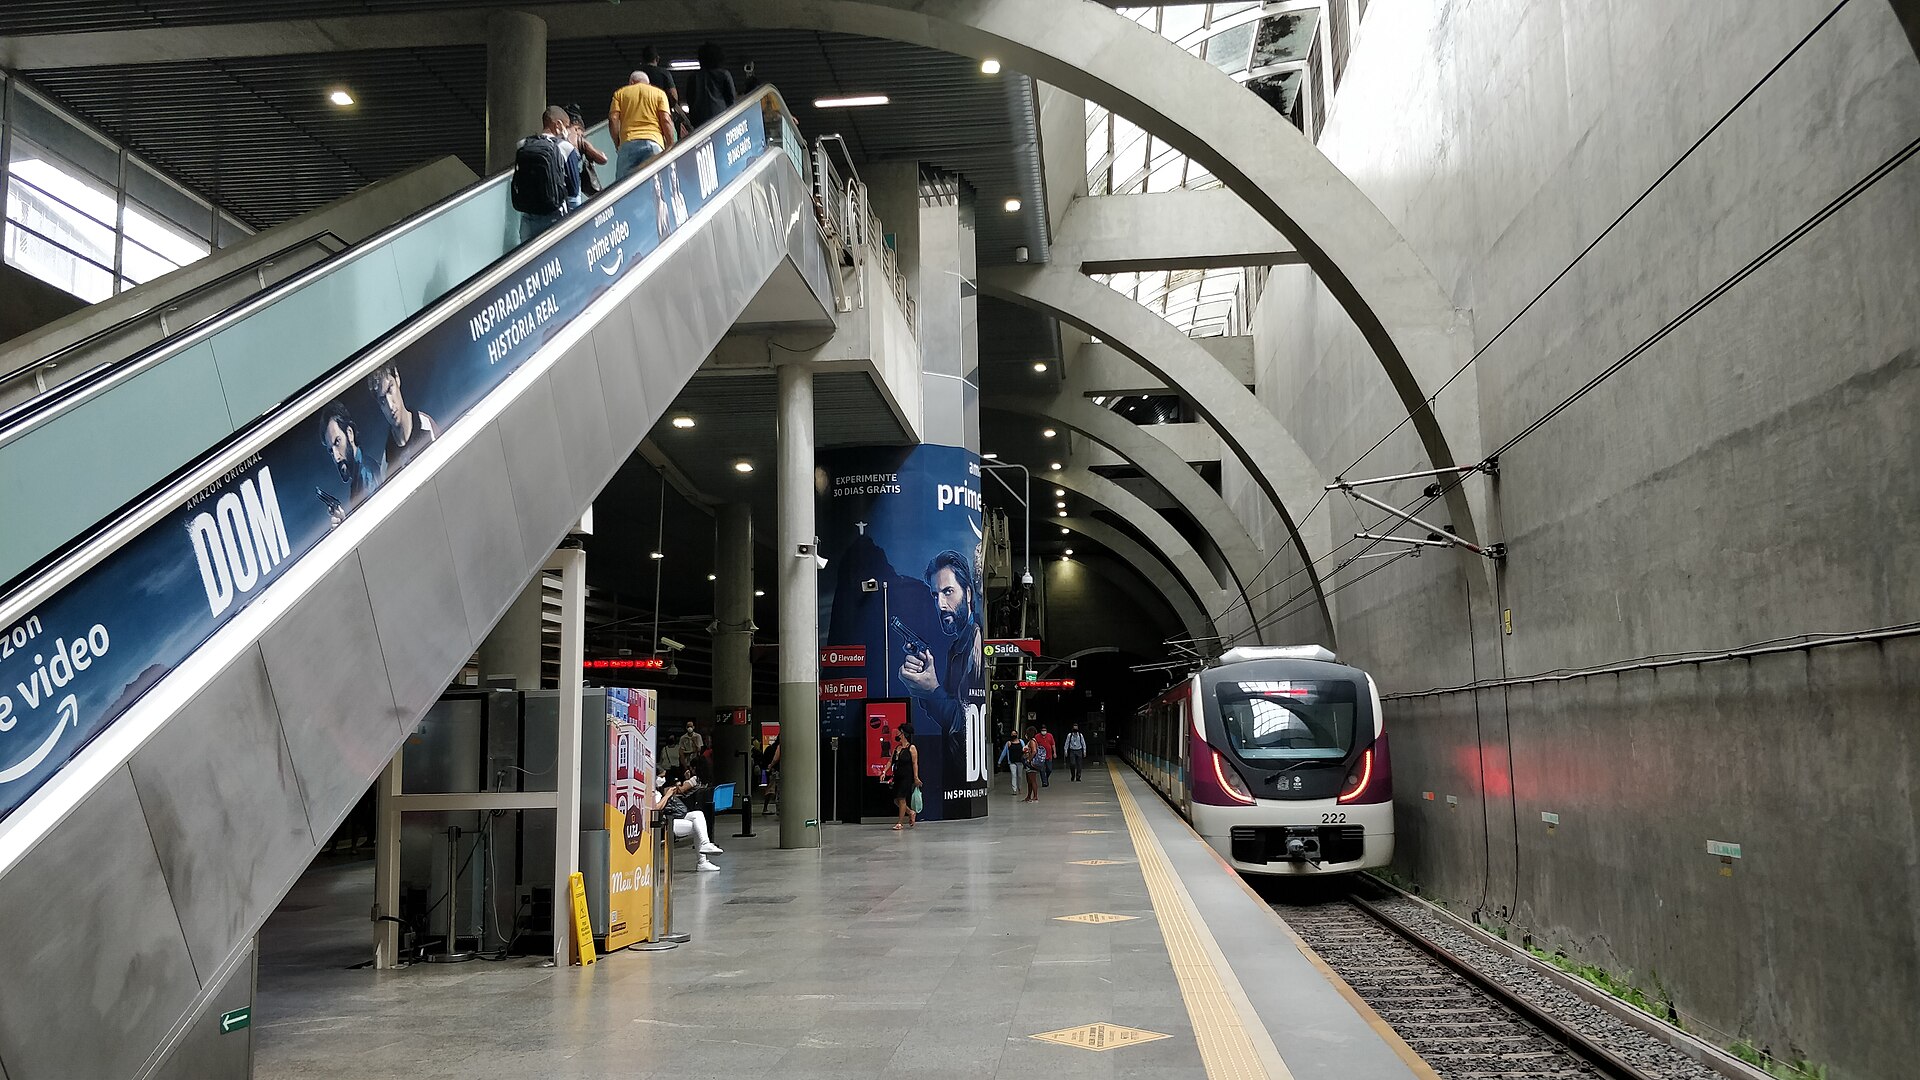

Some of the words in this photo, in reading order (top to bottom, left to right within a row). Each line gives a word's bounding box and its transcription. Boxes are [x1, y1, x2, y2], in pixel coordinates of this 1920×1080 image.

[696, 141, 719, 200] DOM
[594, 205, 615, 229] amazon
[586, 235, 611, 273] prime
[608, 220, 630, 249] video
[469, 284, 527, 342] INSPIRADA
[525, 271, 542, 299] EM
[540, 256, 563, 287] UMA
[487, 311, 537, 365] HISTÓRIA
[535, 293, 560, 326] REAL
[186, 477, 223, 511] AMAZON
[224, 452, 264, 484] ORIGINAL
[833, 488, 843, 498] 30
[844, 486, 864, 496] DIAS
[866, 483, 901, 494] GRÁTIS
[835, 473, 898, 486] EXPERIMENTE
[184, 465, 291, 619] DOM
[0, 614, 43, 661] zon
[994, 644, 1020, 654] Saída
[16, 623, 110, 710] video
[838, 654, 865, 662] Elevador
[824, 683, 838, 694] Não
[839, 683, 863, 693] Fume
[944, 790, 979, 800] INSPIRADA
[1322, 813, 1347, 824] 222
[611, 870, 633, 894] Meu
